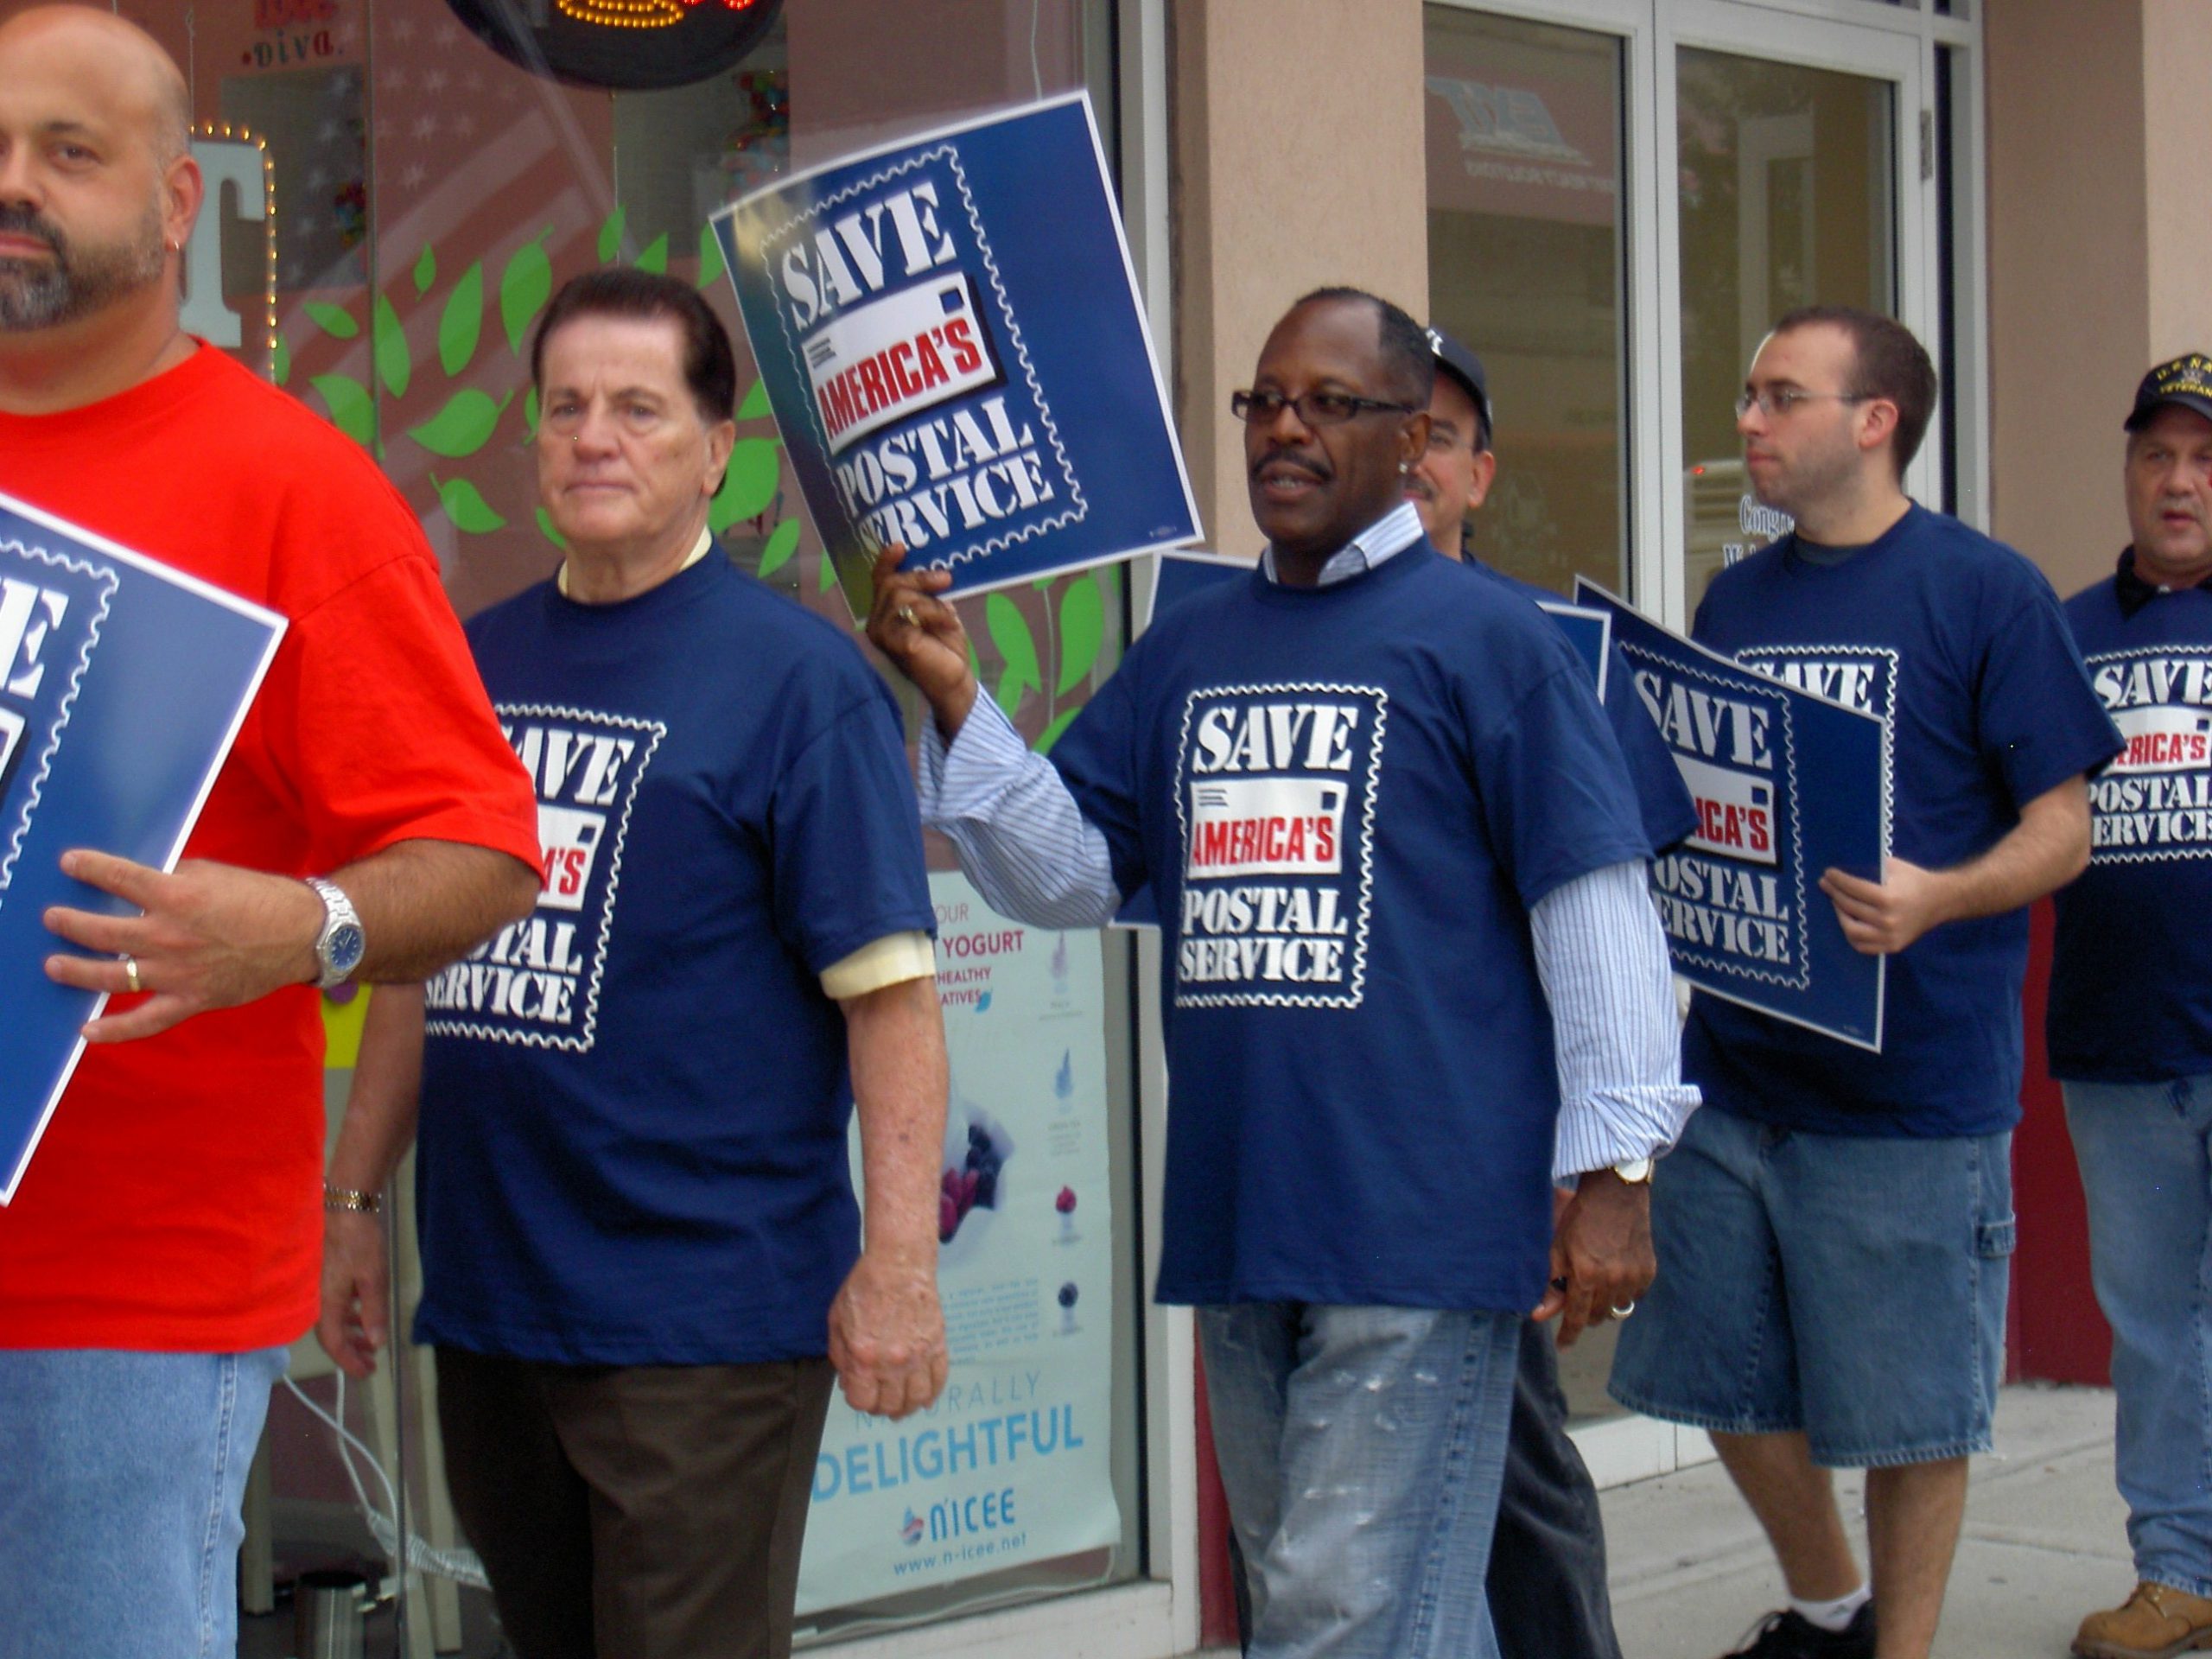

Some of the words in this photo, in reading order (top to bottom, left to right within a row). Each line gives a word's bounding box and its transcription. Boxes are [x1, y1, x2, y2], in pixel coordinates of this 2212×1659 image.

[782, 181, 957, 332] SAVE
[817, 317, 982, 439] AMERICA'S
[836, 396, 1035, 518] POSTAL
[858, 450, 1055, 555] SERVICE
[501, 725, 635, 807] AVE
[1192, 704, 1359, 773] SAVE
[1193, 816, 1334, 868] AMERICA'S
[2092, 810, 2212, 847] ERVICE
[1181, 887, 1348, 936] POSTAL
[1654, 855, 1789, 921] OSTAL
[467, 918, 583, 976] TAL
[942, 930, 1024, 960] YOGURT
[1179, 938, 1345, 983] SERVICE
[1652, 891, 1790, 964] ERVICE
[937, 967, 992, 986] HEALTHY
[940, 989, 982, 1007] ATIVES
[810, 1403, 1084, 1503] DELIGHTFUL
